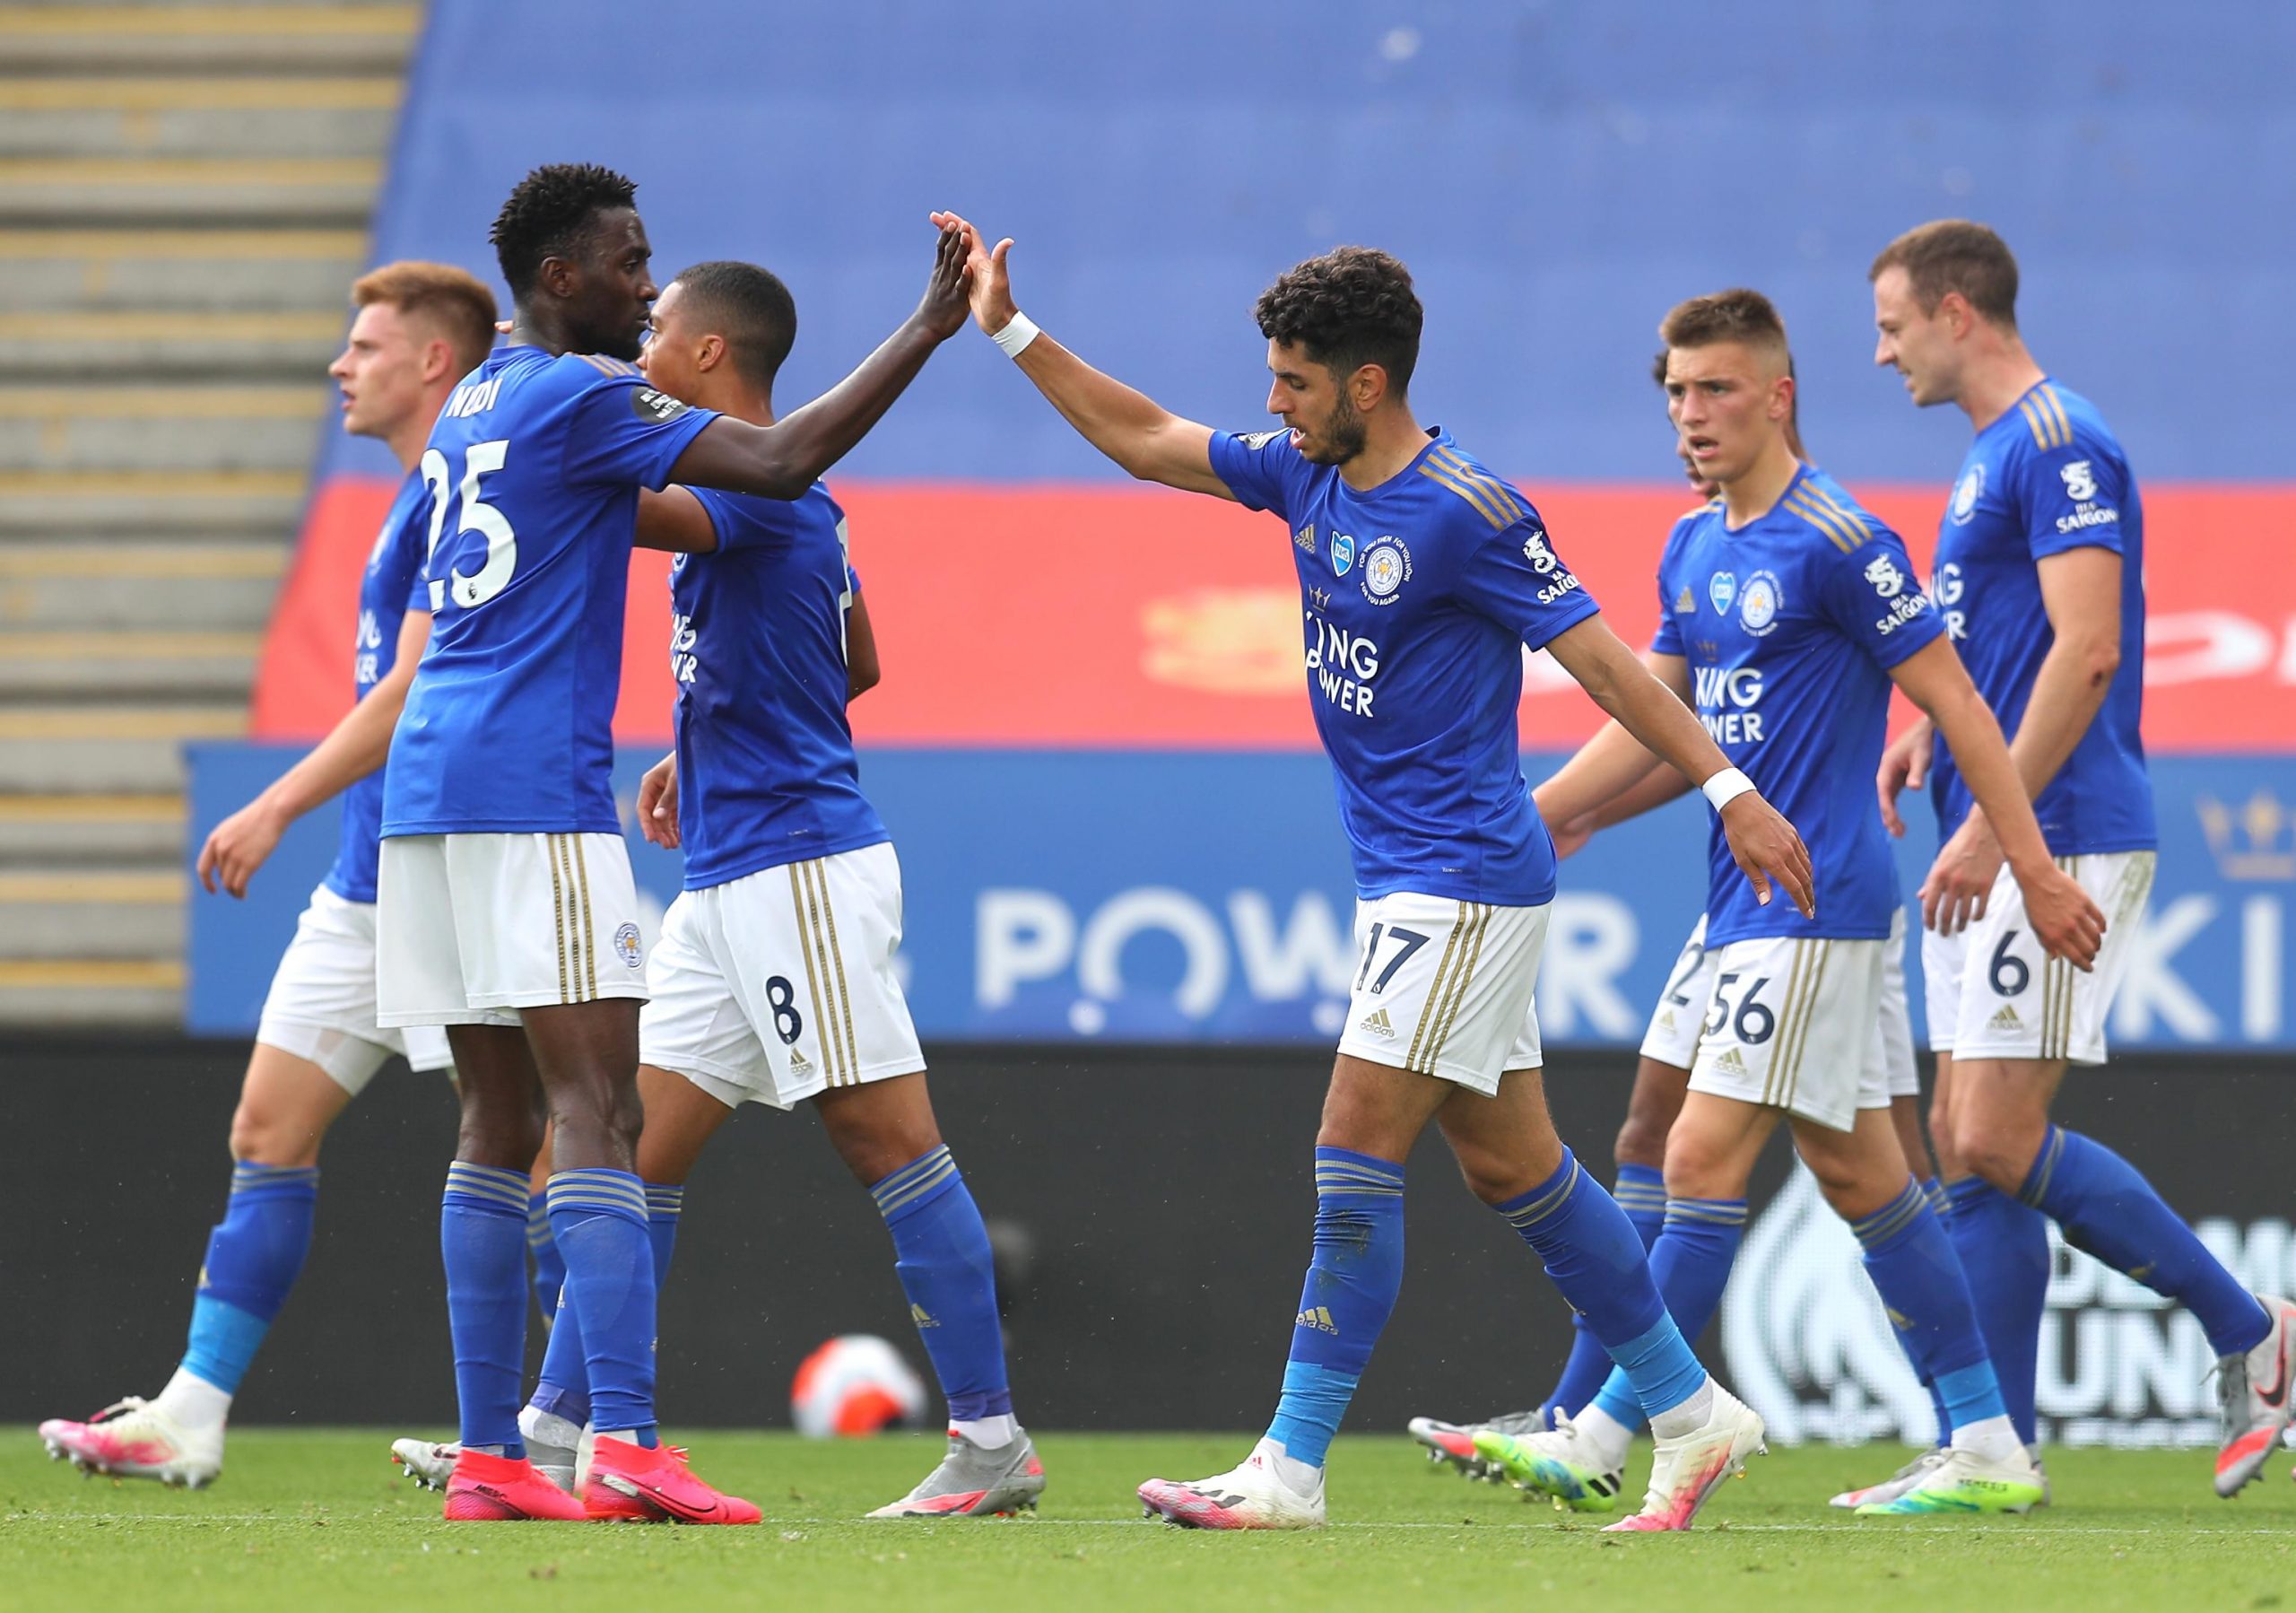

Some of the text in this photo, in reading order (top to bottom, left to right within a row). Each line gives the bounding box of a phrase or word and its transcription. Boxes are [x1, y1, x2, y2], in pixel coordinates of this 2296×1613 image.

[421, 440, 517, 612] 25
[2056, 508, 2118, 534] SAIGON
[1306, 610, 1378, 680] ING
[1875, 595, 1928, 635] SAIGON
[975, 886, 1641, 1040] POWR
[1356, 922, 1431, 995] 17
[1988, 930, 2030, 997] 6
[766, 975, 803, 1045] 8
[1360, 1022, 1396, 1038] adidas
[1707, 973, 1775, 1045] 56
